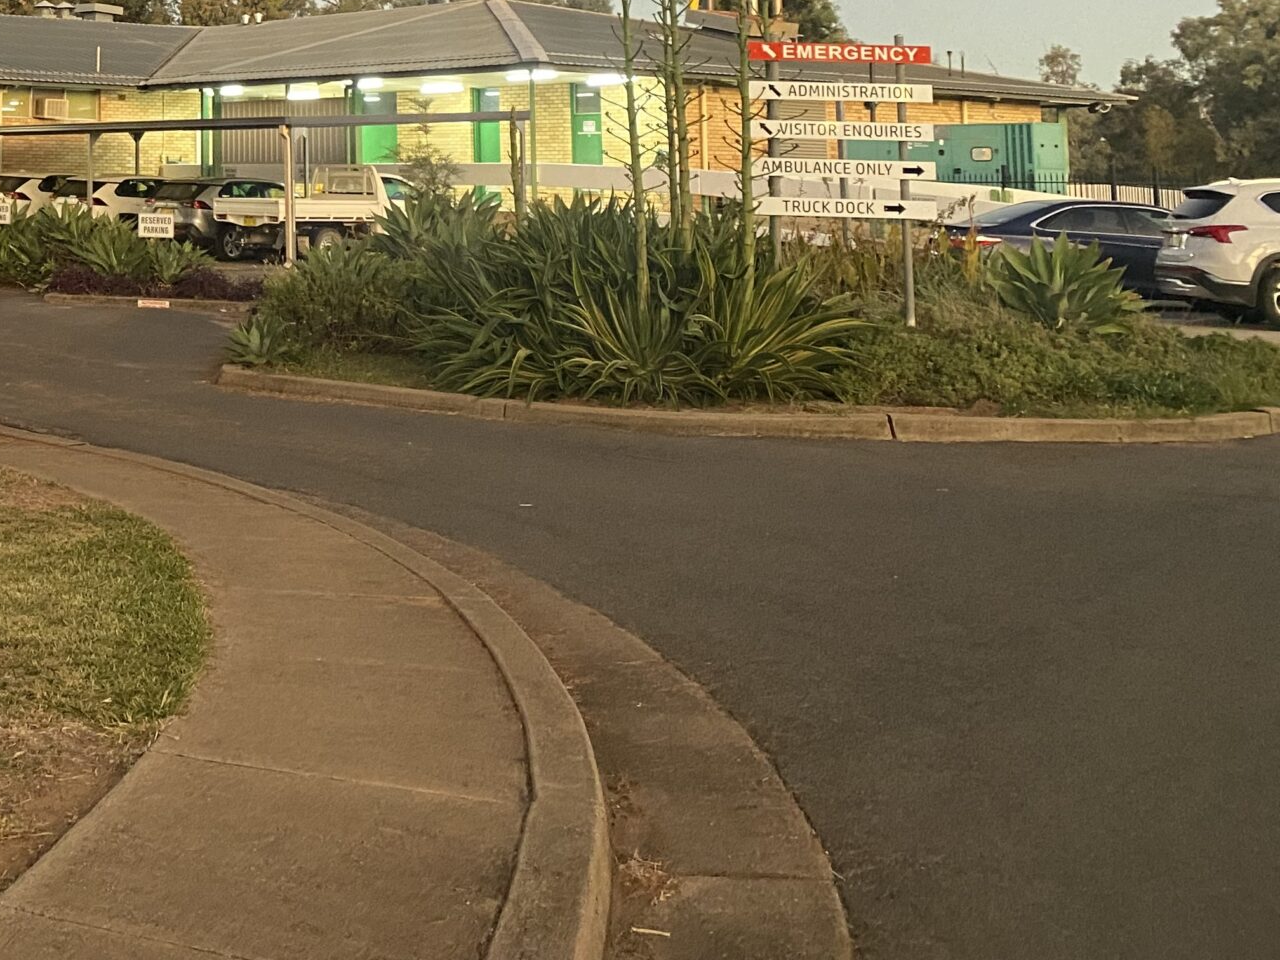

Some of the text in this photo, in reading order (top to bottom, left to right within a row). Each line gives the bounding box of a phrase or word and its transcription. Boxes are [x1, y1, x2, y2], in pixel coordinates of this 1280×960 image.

[782, 44, 918, 62] EMERGENCY
[788, 84, 913, 99] ADMINISTRATION
[779, 122, 922, 138] VISITOR ENQUIRIES
[761, 160, 893, 175] AMBULANCE ONLY
[782, 200, 875, 214] TRUCK DOCK
[140, 216, 172, 224] RESERVED
[143, 226, 169, 234] PARKING
